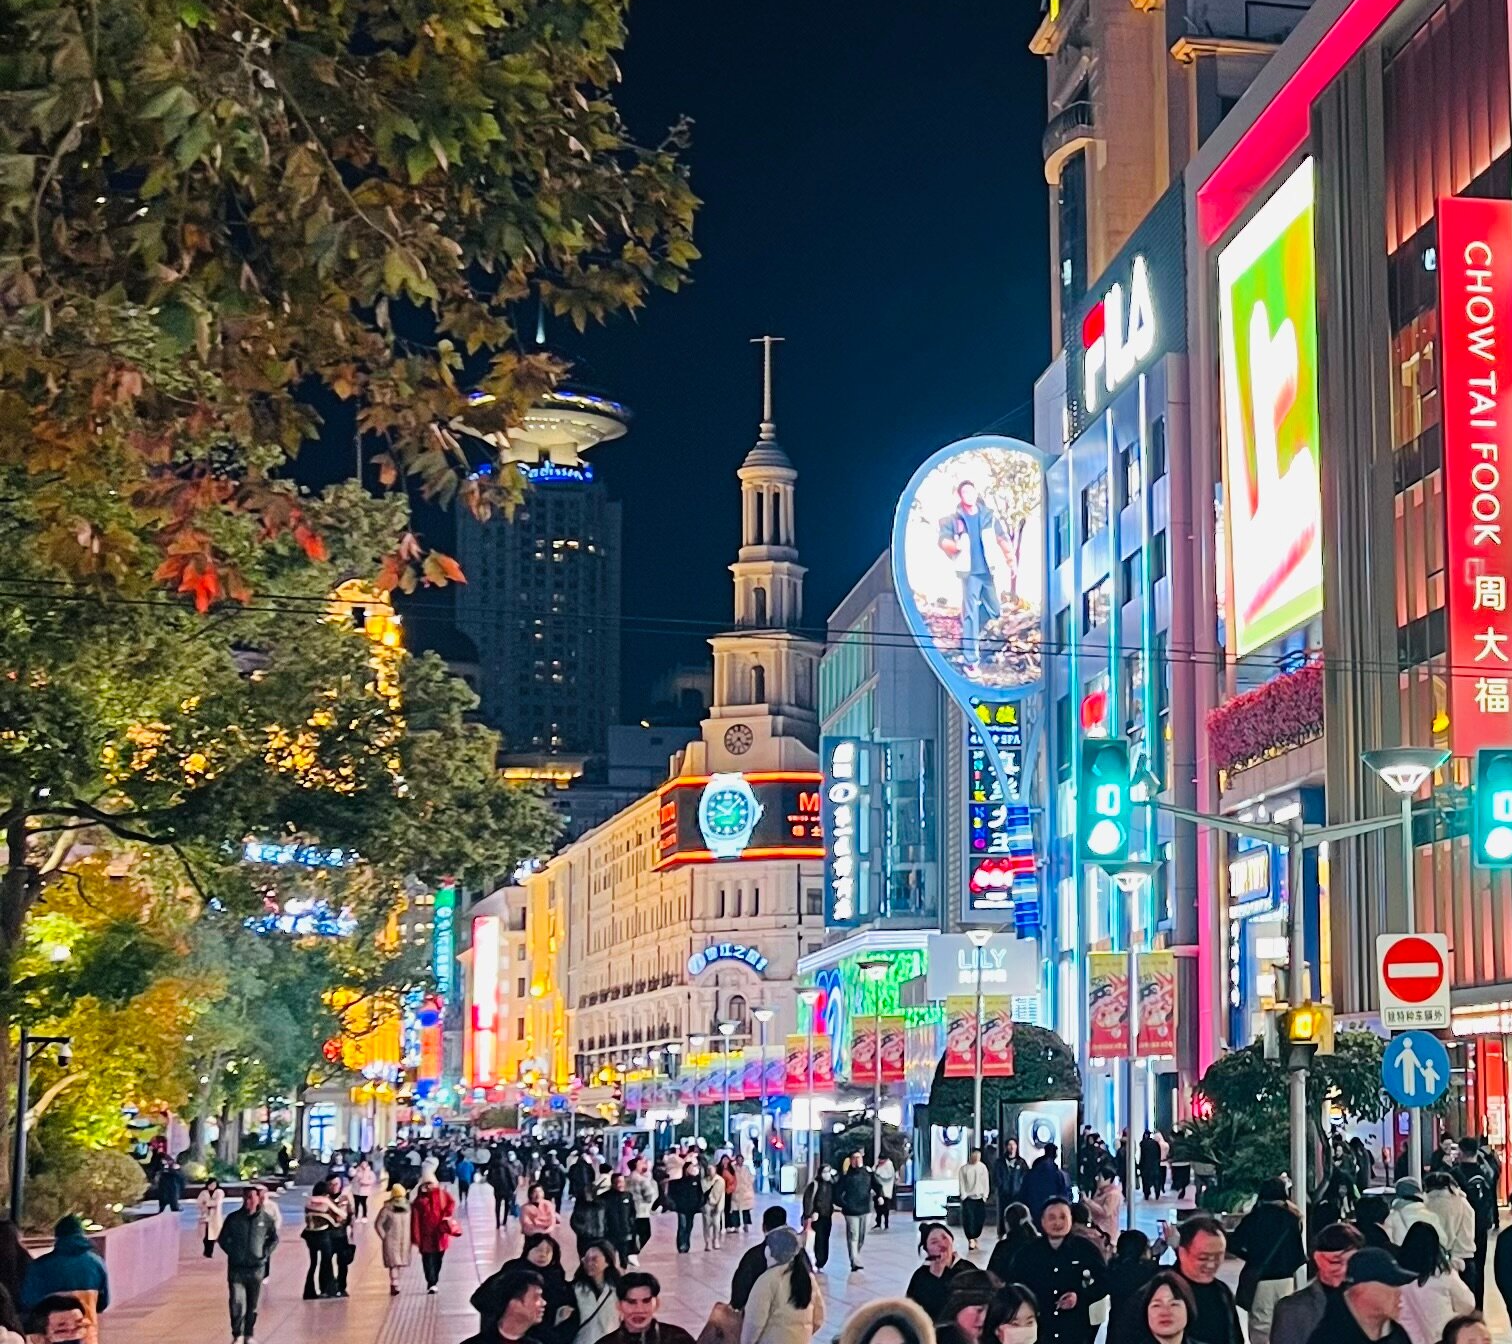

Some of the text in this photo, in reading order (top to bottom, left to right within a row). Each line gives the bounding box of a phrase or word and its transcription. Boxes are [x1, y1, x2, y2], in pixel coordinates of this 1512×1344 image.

[1082, 254, 1155, 413] FILA
[1463, 240, 1502, 546] CHOW TAI FOOK
[1473, 575, 1510, 713] 周大福
[1000, 734, 1021, 745] SPA
[797, 792, 820, 812] M
[958, 948, 1007, 969] LILY
